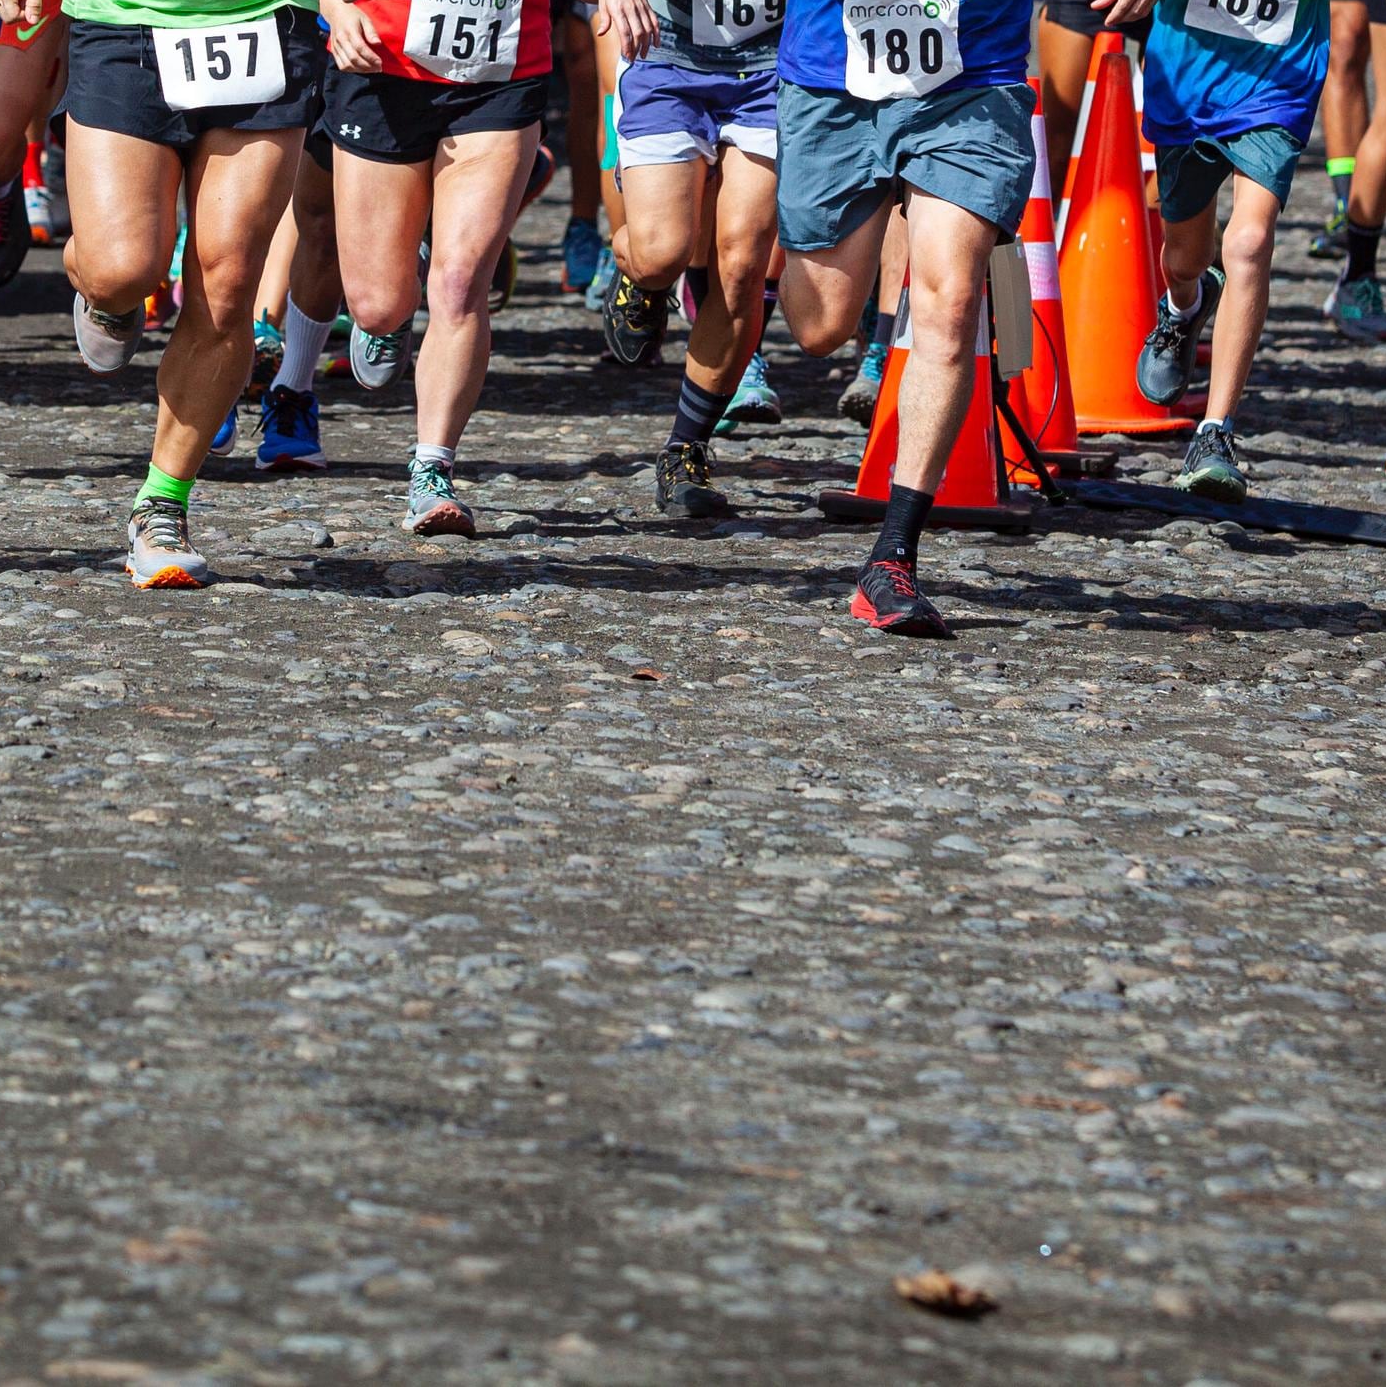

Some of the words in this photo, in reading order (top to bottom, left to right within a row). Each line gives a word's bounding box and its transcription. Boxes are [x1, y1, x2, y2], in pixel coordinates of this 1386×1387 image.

[174, 31, 259, 83] 157
[428, 13, 503, 62] 151
[860, 27, 944, 75] 180
